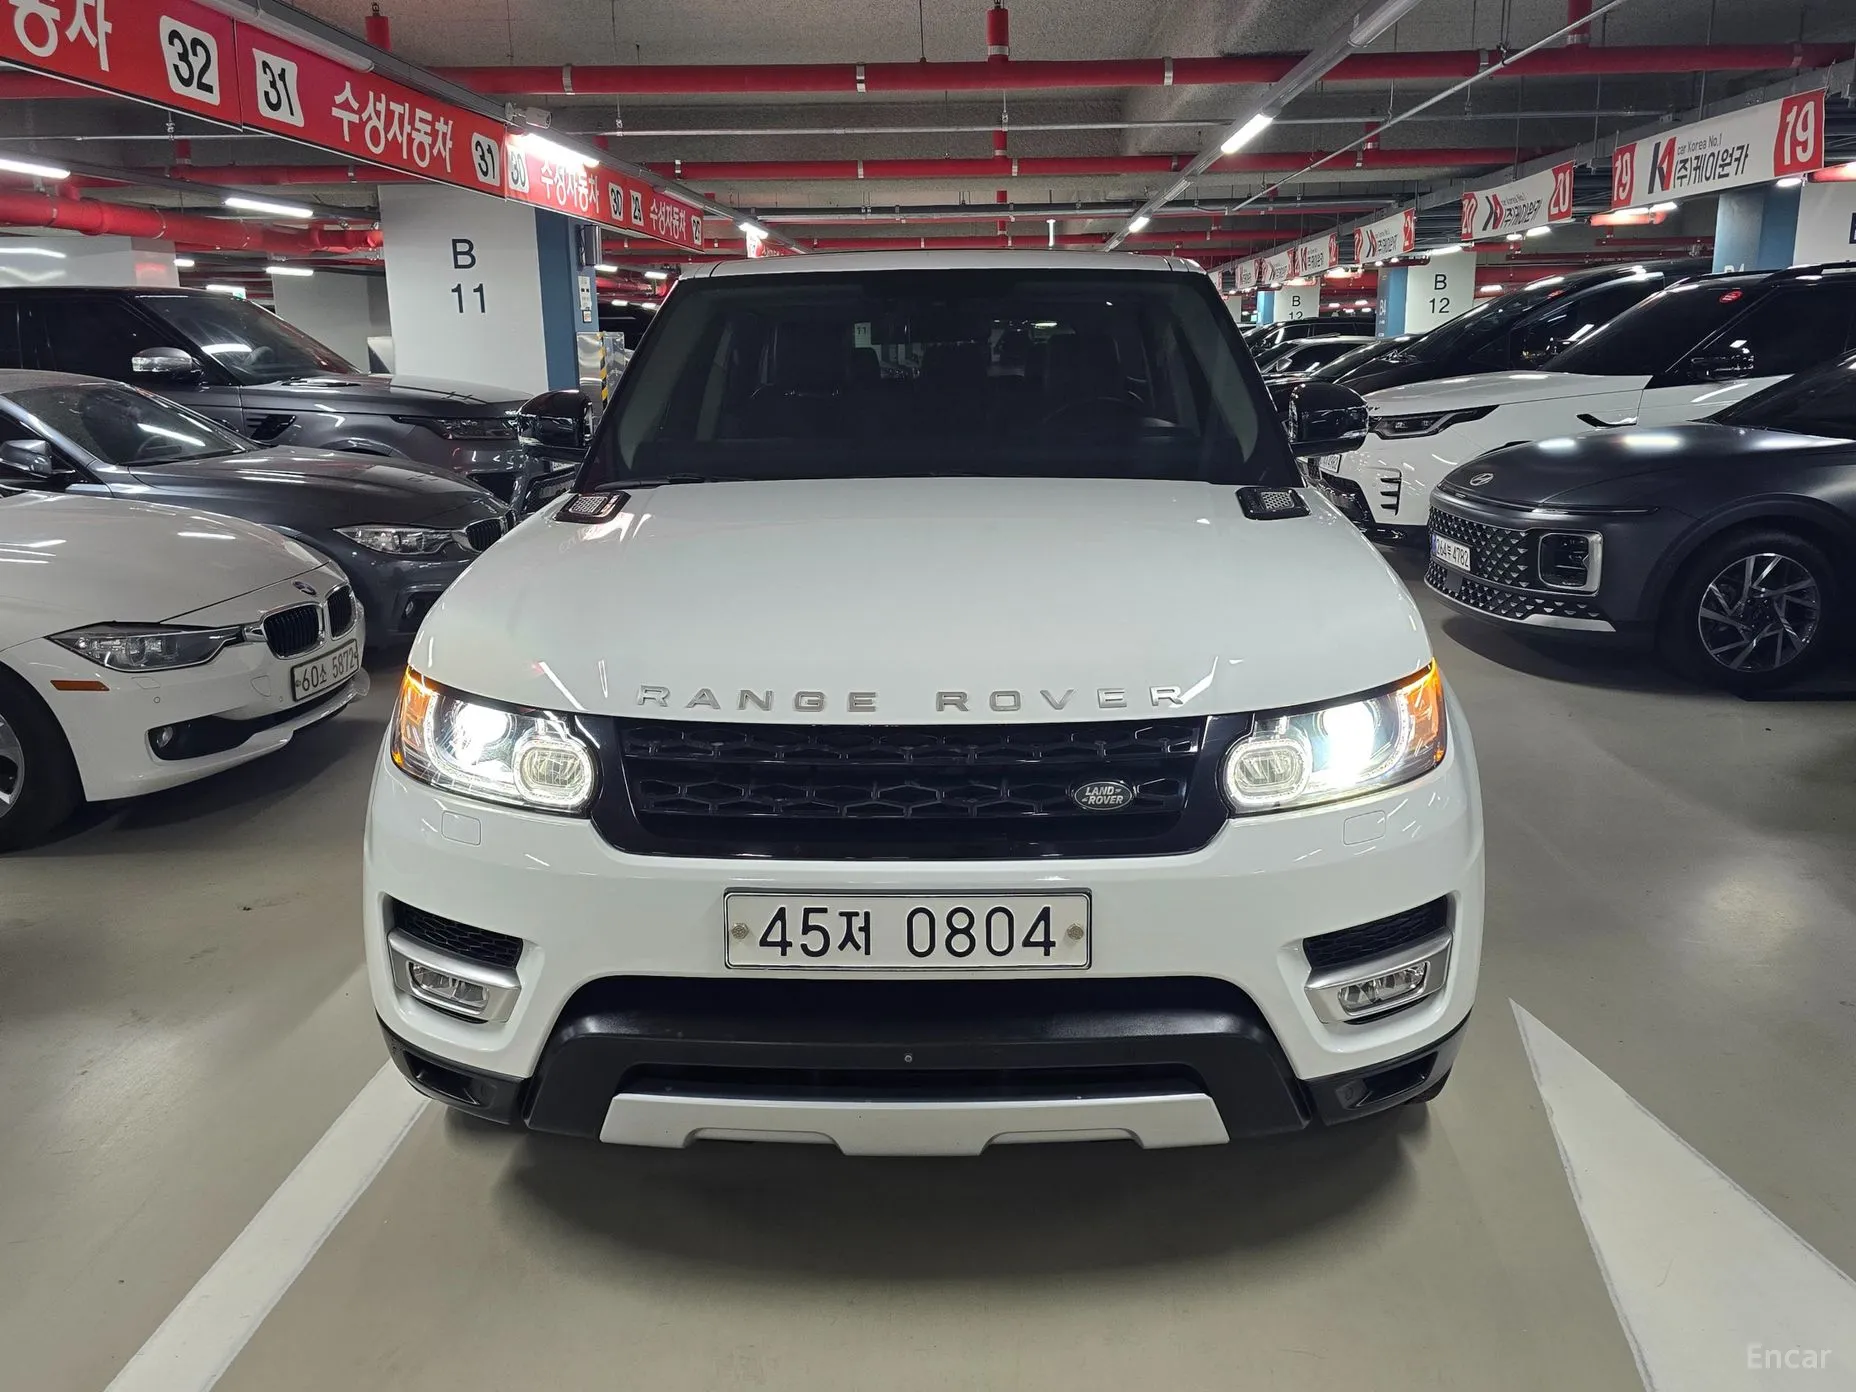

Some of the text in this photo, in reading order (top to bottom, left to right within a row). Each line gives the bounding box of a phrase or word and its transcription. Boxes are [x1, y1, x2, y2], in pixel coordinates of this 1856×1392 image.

[168, 29, 214, 94] 32
[261, 60, 496, 179] 31 수성자동차 31
[1784, 101, 1815, 165] 19
[1688, 140, 1706, 152] Korea
[1614, 152, 1631, 200] 19
[1674, 143, 1749, 188] (주)케이원카
[511, 151, 526, 187] 30
[611, 187, 622, 217] 30
[649, 198, 687, 240] 수성자동차
[452, 239, 476, 269] B
[1434, 274, 1447, 290] B
[451, 283, 485, 313] 11
[1292, 296, 1301, 306] B
[1429, 297, 1450, 313] 12
[1453, 546, 1469, 567] 4782
[302, 649, 355, 692] 60소 5872
[636, 685, 1184, 712] RANGE ROVER
[1085, 786, 1115, 796] LAND
[1087, 795, 1124, 805] ROVER
[759, 906, 1056, 958] 45저 0804
